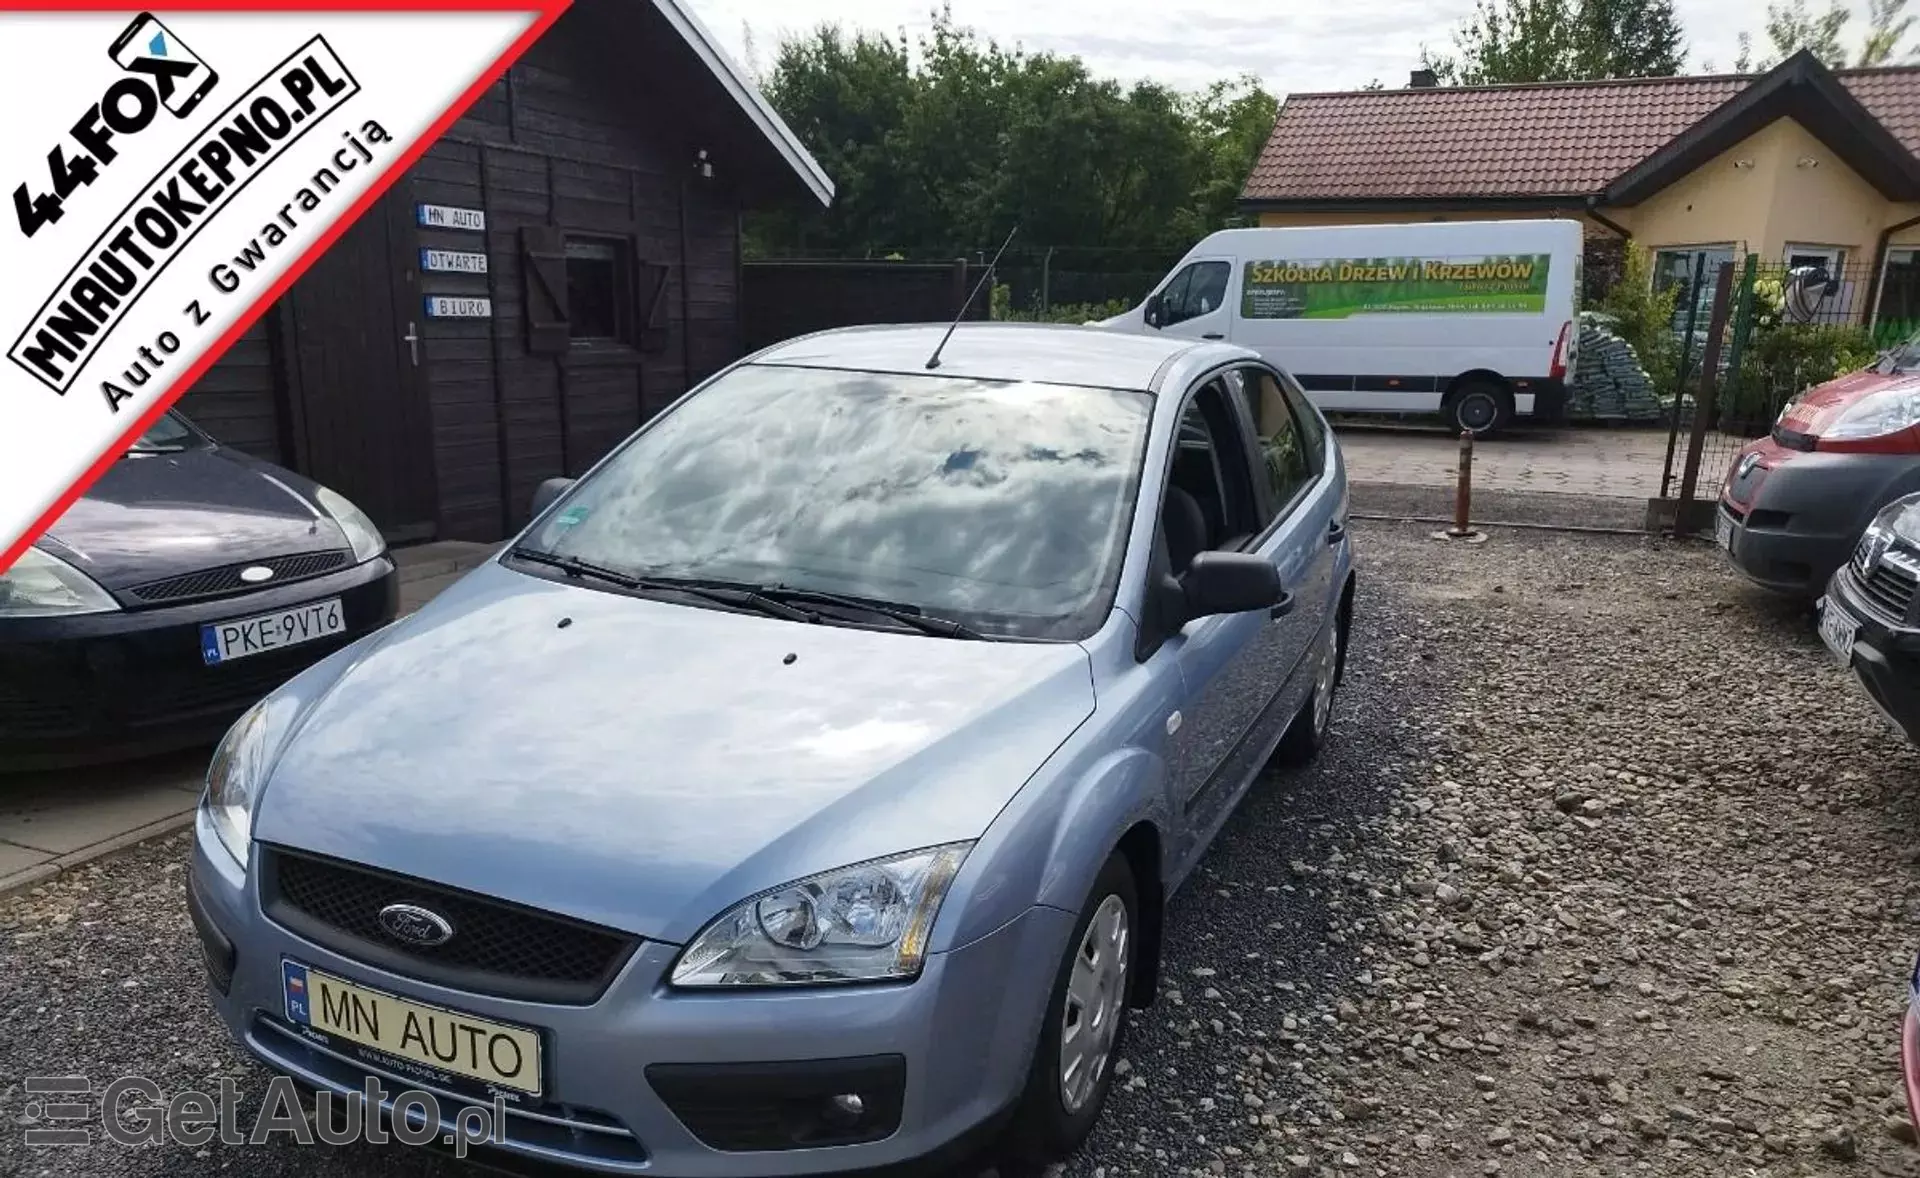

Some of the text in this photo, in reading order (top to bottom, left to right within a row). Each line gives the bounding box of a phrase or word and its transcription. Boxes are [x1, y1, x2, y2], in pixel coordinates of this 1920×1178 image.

[452, 210, 481, 228] AUTO
[430, 252, 486, 272] OTWARTE
[440, 299, 485, 315] BIURO
[320, 983, 523, 1078] MN AUTO
